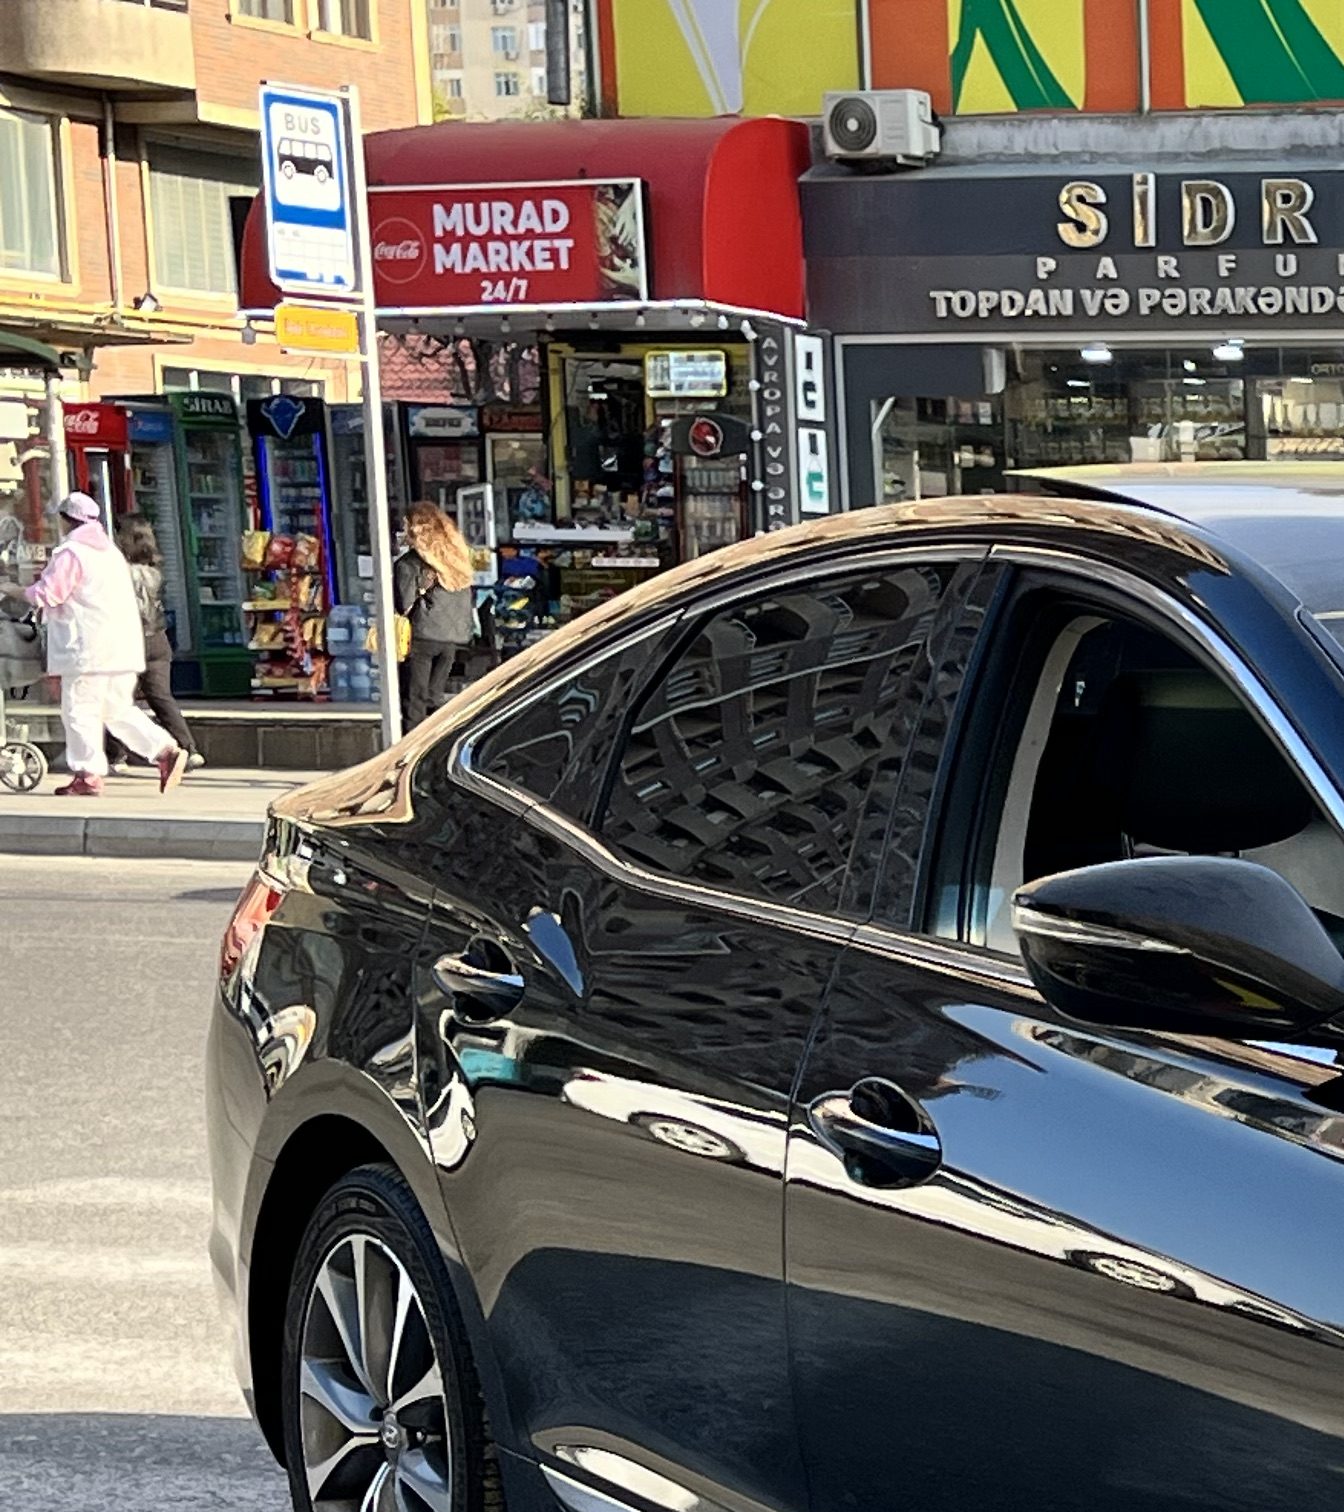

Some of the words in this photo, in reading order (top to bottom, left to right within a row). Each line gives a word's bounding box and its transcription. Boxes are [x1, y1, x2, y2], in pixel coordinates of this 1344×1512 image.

[284, 113, 320, 135] BUS
[432, 199, 570, 237] MURAD
[433, 239, 574, 276] MARKET
[480, 277, 528, 302] 24/7
[929, 288, 1074, 319] TOPDAN
[1080, 287, 1130, 317] VƏ
[761, 336, 781, 435] AVROPA
